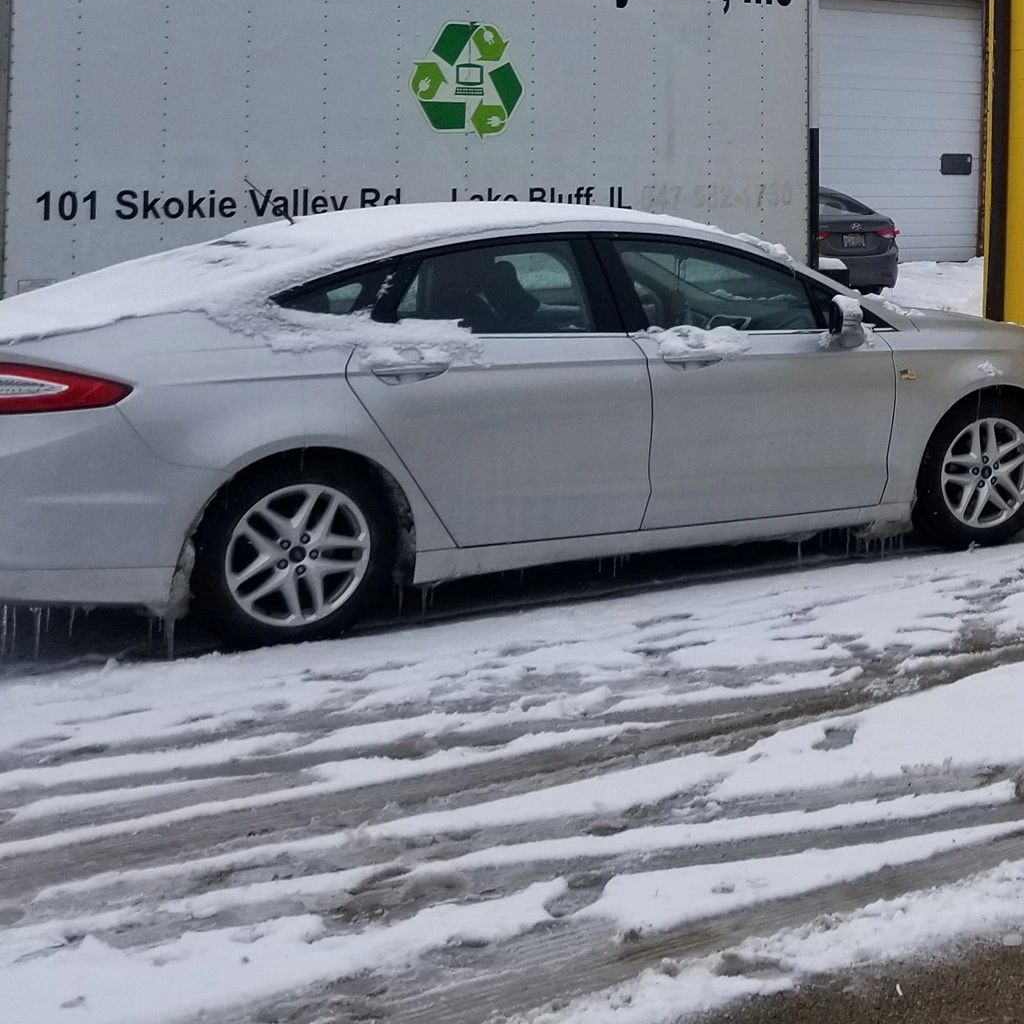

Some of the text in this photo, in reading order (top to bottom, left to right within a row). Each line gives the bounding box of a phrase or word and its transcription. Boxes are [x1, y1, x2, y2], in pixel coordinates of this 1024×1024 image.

[36, 190, 98, 221] 101
[115, 189, 237, 220] Skokie
[610, 186, 632, 209] IL
